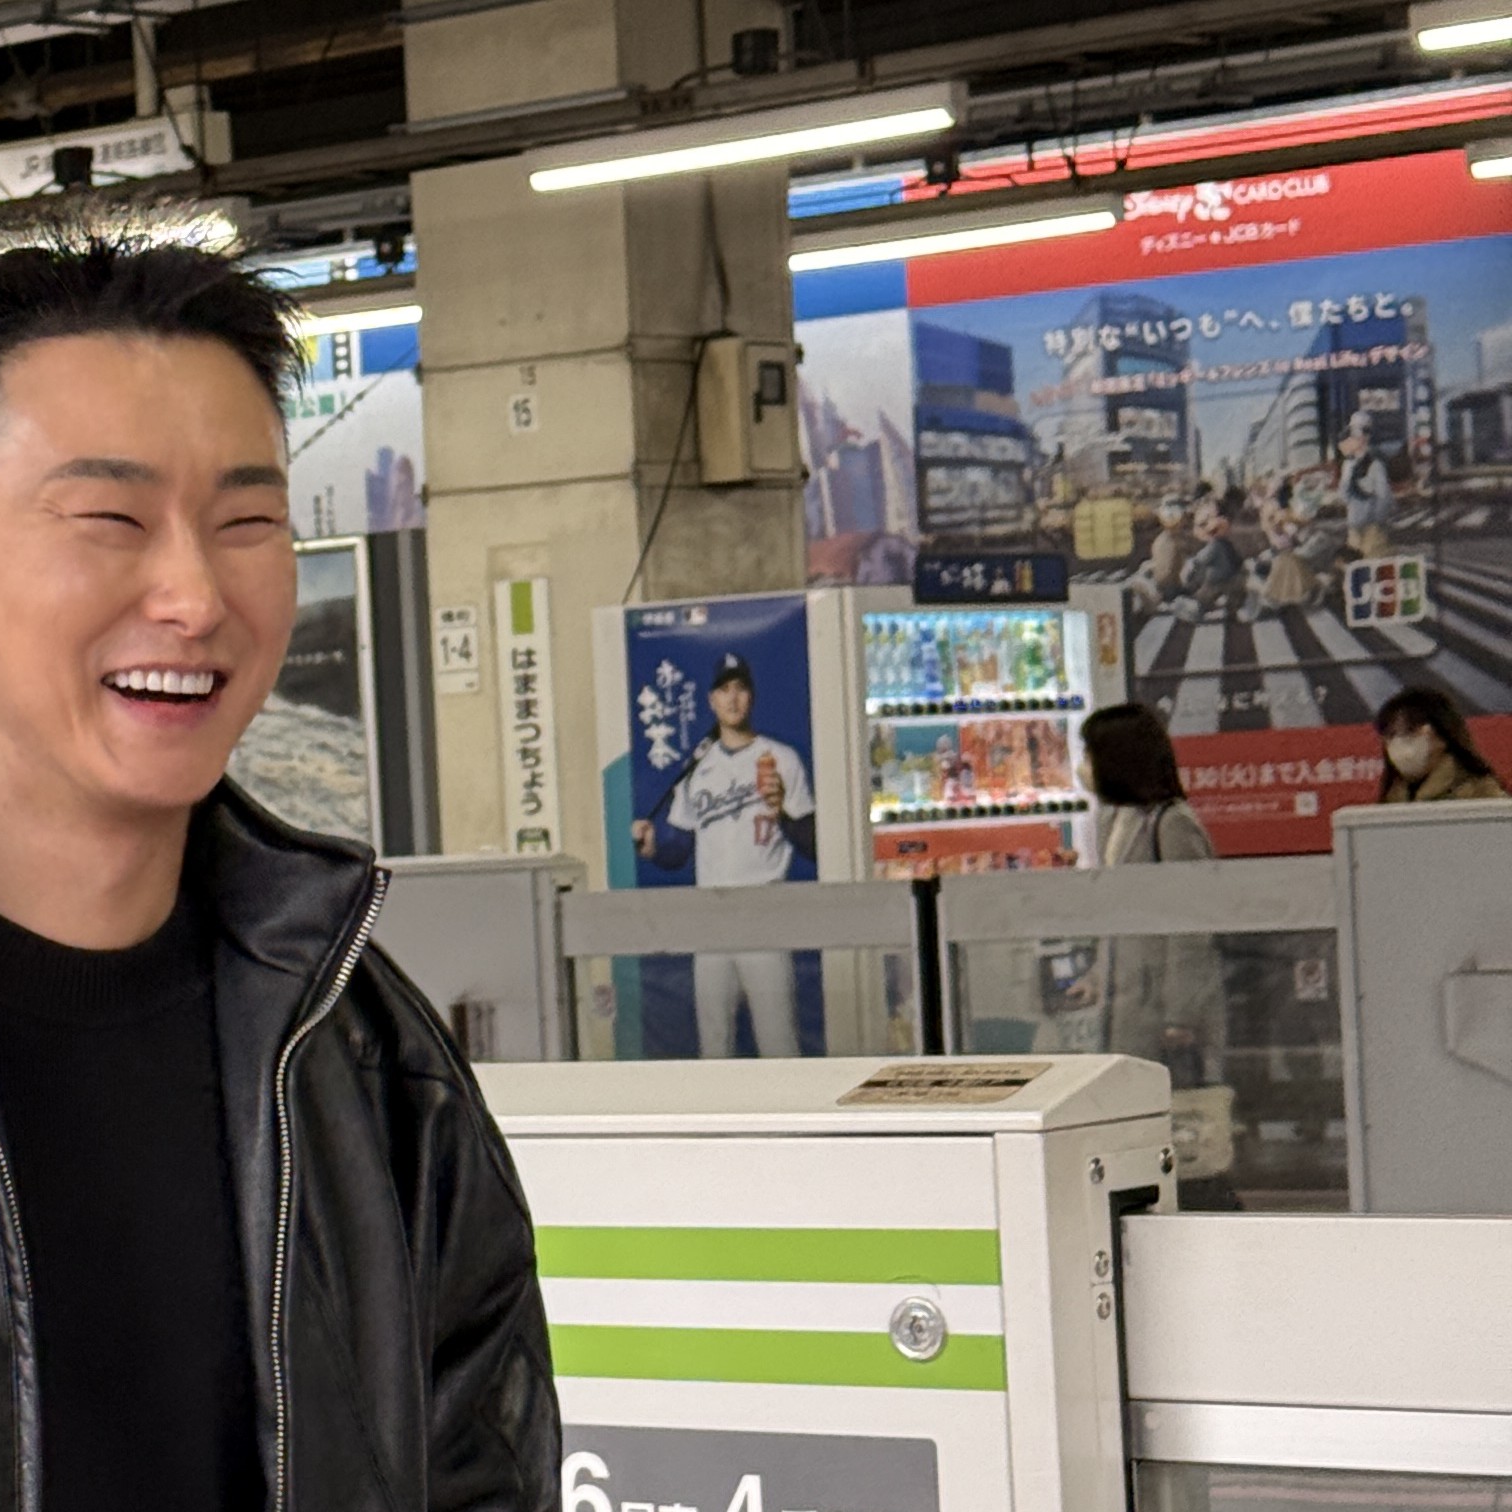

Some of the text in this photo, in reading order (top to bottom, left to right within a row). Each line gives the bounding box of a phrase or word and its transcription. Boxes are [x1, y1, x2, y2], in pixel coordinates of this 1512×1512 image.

[512, 398, 533, 428] 15
[511, 646, 545, 817] はままつちょう
